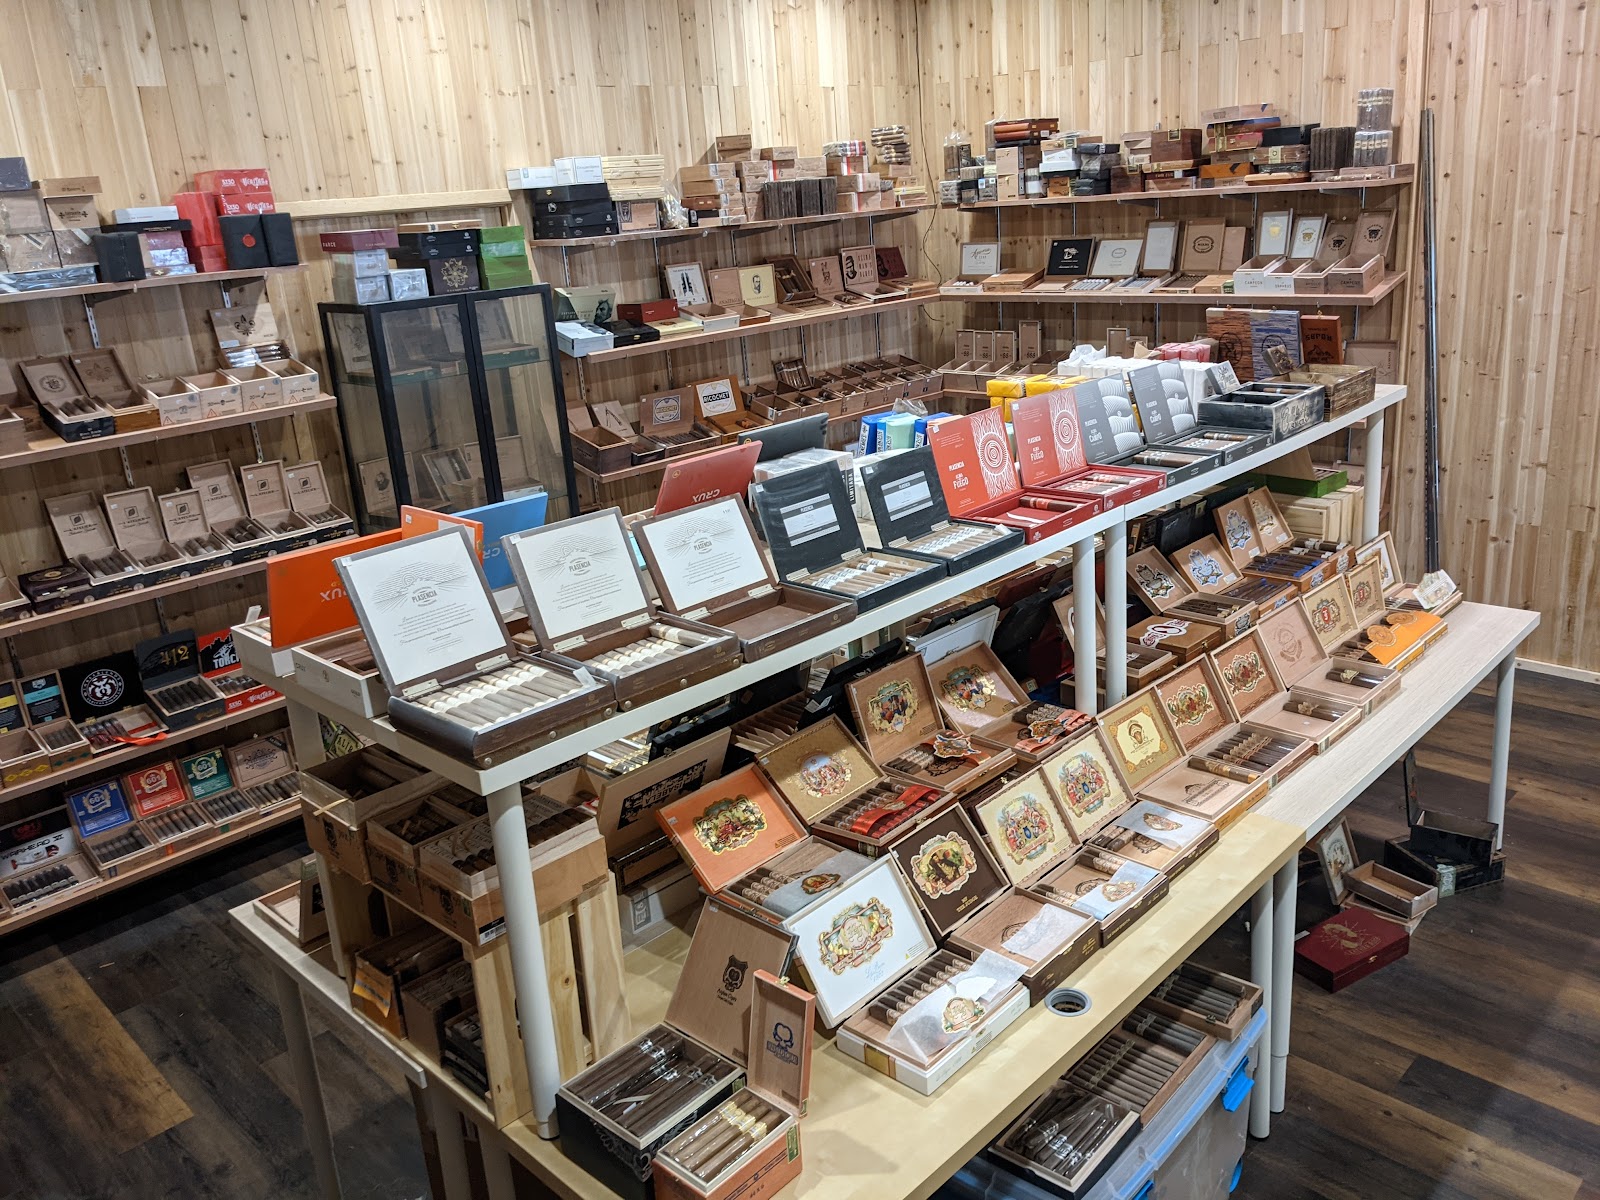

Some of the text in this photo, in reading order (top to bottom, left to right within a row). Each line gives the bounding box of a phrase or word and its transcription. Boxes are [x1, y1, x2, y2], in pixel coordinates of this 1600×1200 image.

[703, 391, 730, 403] RICOCHET
[953, 476, 969, 490] FUEGO
[692, 488, 721, 503] CRUX
[693, 540, 713, 551] PLASENCIA
[483, 547, 501, 560] CR
[568, 560, 592, 572] PLASENCIA
[411, 590, 438, 603] PLASENCIA
[160, 645, 189, 666] 412
[146, 775, 162, 785] 601
[89, 793, 105, 805] 601
[646, 783, 685, 804] ISABELA
[1, 838, 51, 860] WARHEAD
